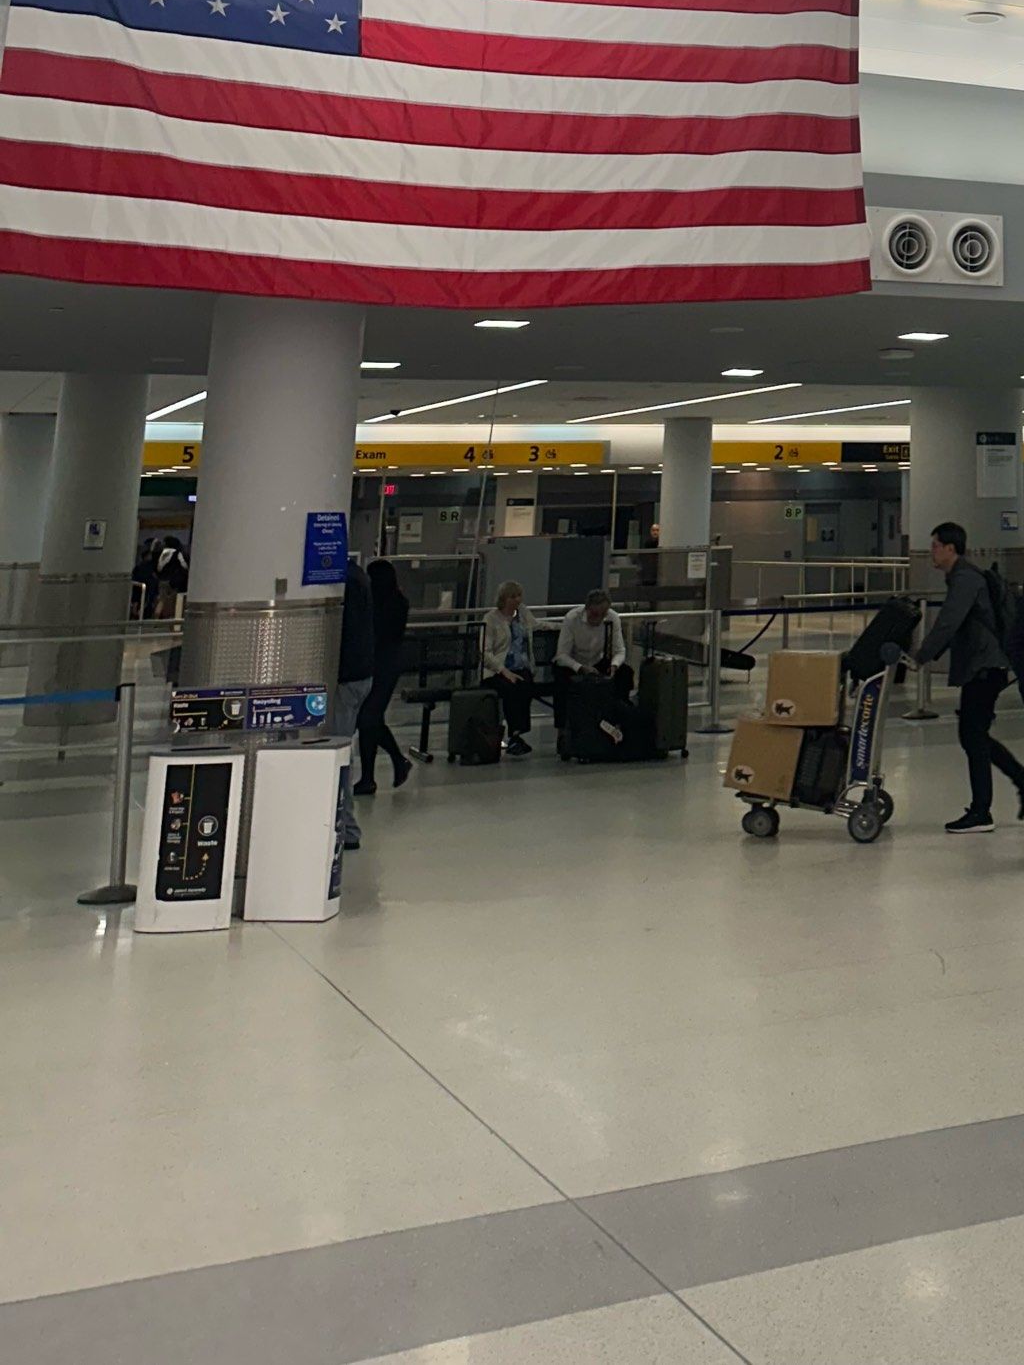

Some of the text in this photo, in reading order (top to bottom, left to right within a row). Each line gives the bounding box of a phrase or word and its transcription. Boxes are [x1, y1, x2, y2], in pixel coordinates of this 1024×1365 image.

[182, 446, 194, 463] 5
[356, 449, 386, 460] Exam
[464, 447, 476, 463] 4
[528, 447, 540, 463] 3
[774, 445, 784, 460] 2
[883, 445, 899, 453] Exit
[450, 511, 459, 522] R
[785, 507, 802, 518] 8 P
